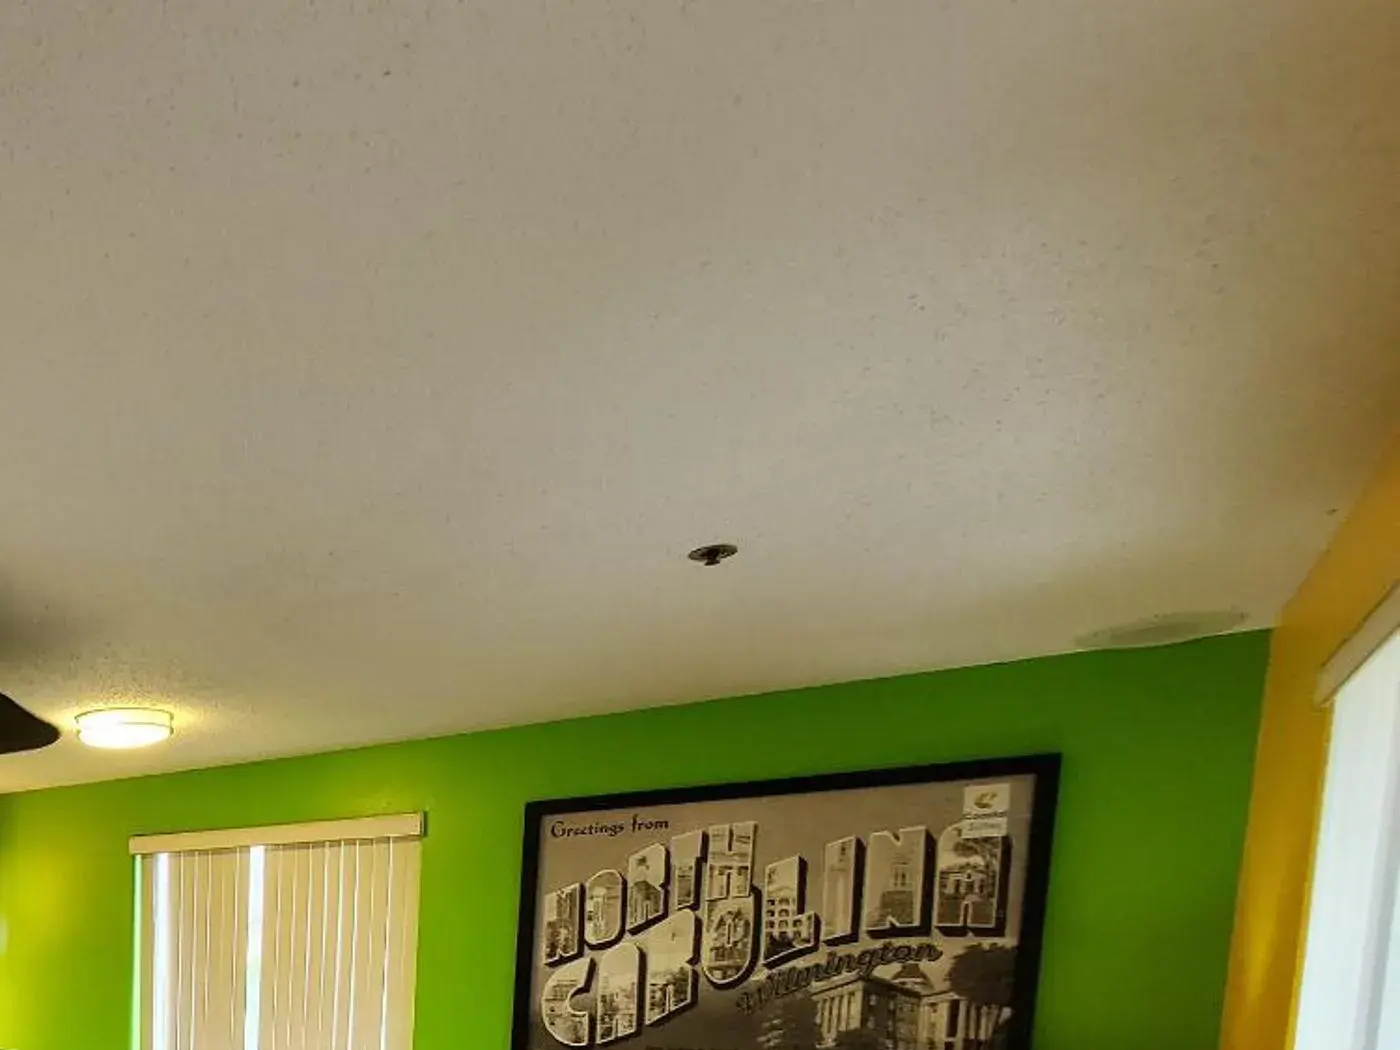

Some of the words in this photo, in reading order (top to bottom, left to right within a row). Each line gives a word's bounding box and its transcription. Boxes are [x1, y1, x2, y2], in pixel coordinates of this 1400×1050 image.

[550, 820, 625, 838] Greetings
[631, 813, 670, 833] from
[540, 823, 1012, 1048] CAROLINA
[543, 820, 760, 966] NORTH
[736, 940, 944, 1015] Wilmington
